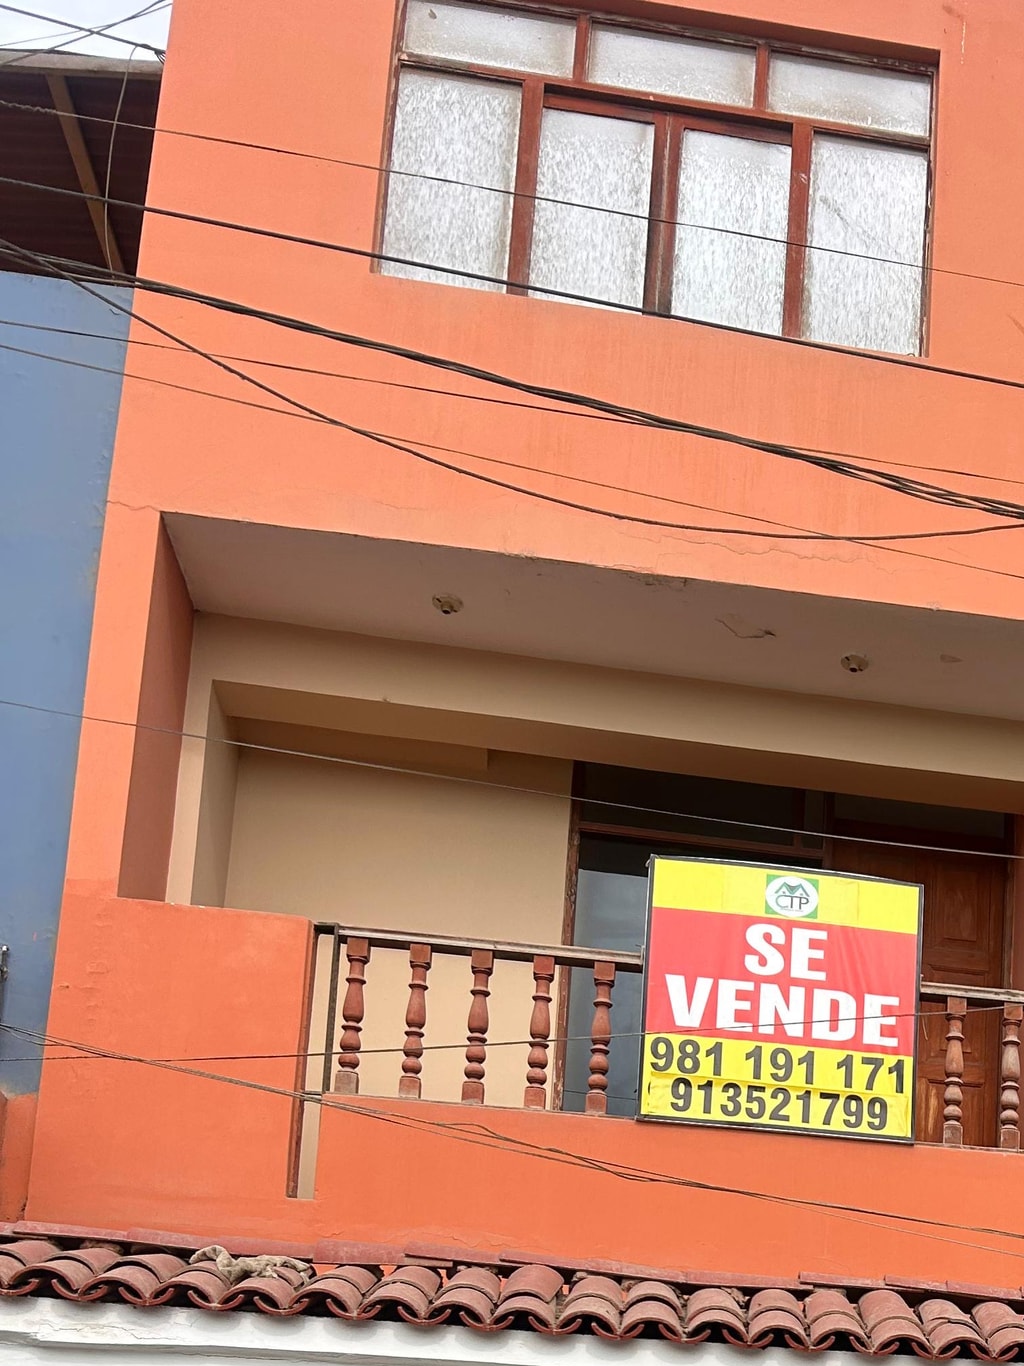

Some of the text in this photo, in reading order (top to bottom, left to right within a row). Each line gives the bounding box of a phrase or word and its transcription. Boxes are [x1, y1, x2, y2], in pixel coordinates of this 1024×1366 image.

[775, 895, 810, 910] CTP
[744, 923, 828, 981] SE
[665, 974, 900, 1047] VENDE
[650, 1037, 905, 1094] 981 191 171
[670, 1077, 888, 1131] 913521799
